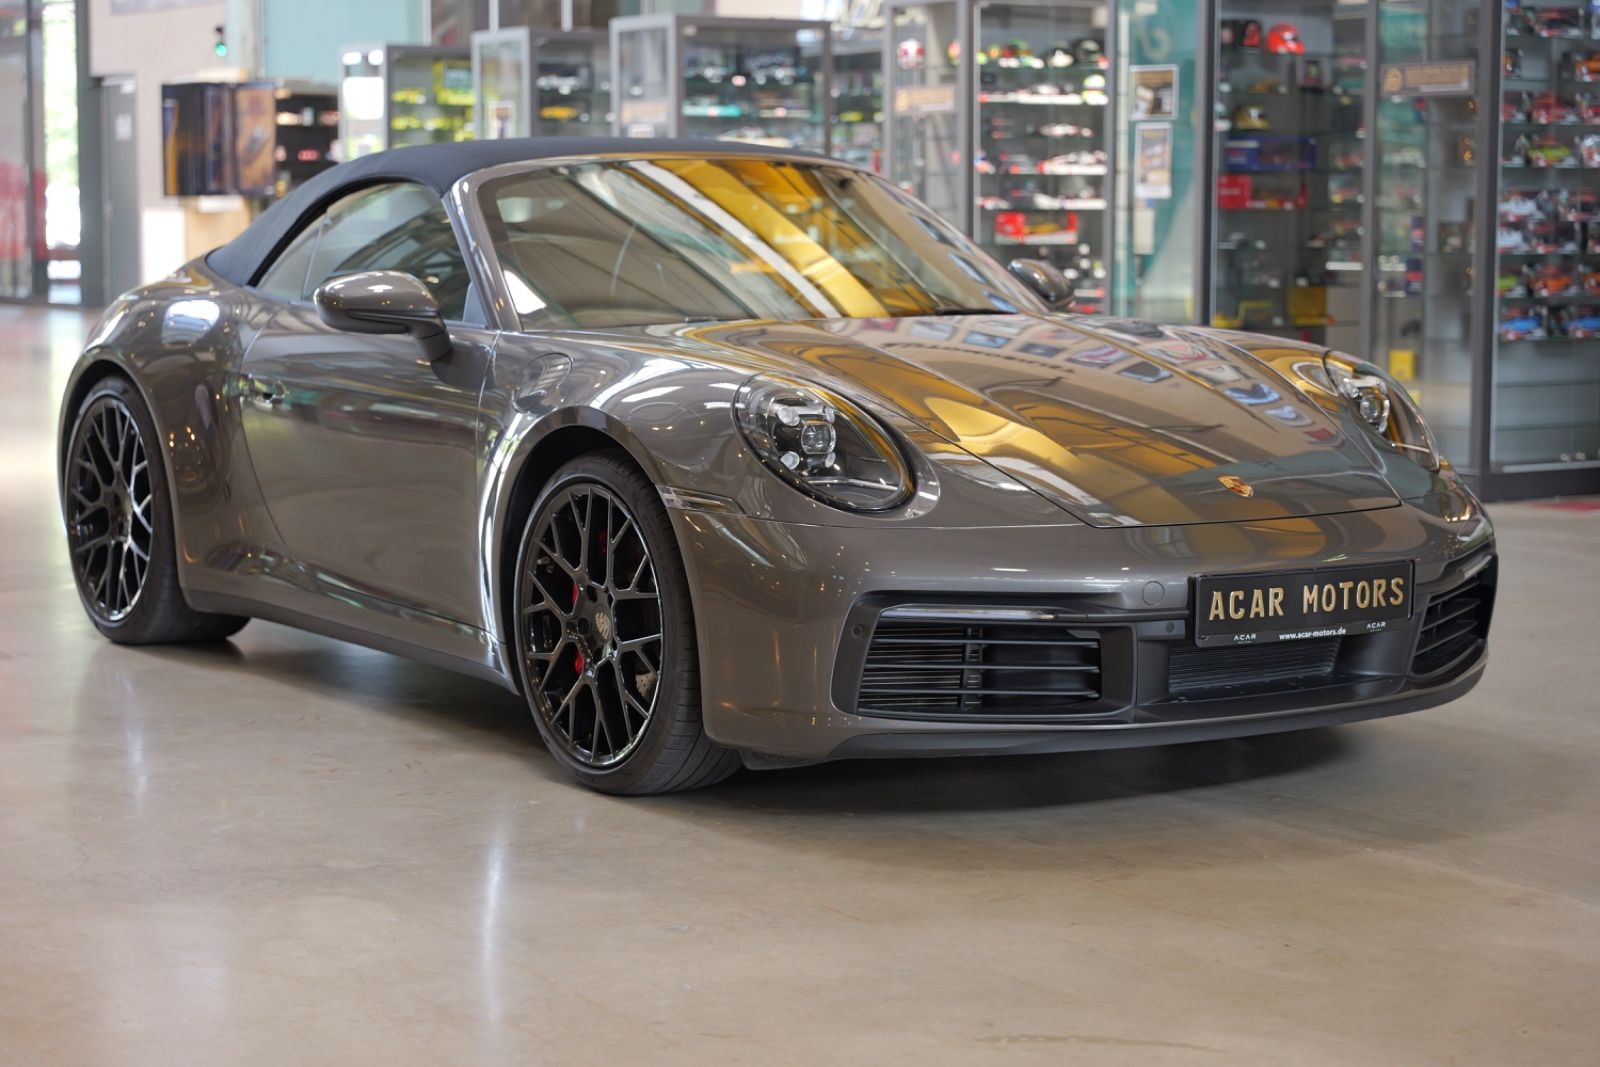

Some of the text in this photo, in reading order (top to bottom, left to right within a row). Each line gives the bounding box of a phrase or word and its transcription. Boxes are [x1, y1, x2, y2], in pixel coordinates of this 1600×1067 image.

[1209, 577, 1404, 621] ACAR MOTORS
[1233, 633, 1257, 641] ACAR
[1279, 626, 1346, 640] www.acar-motors.de
